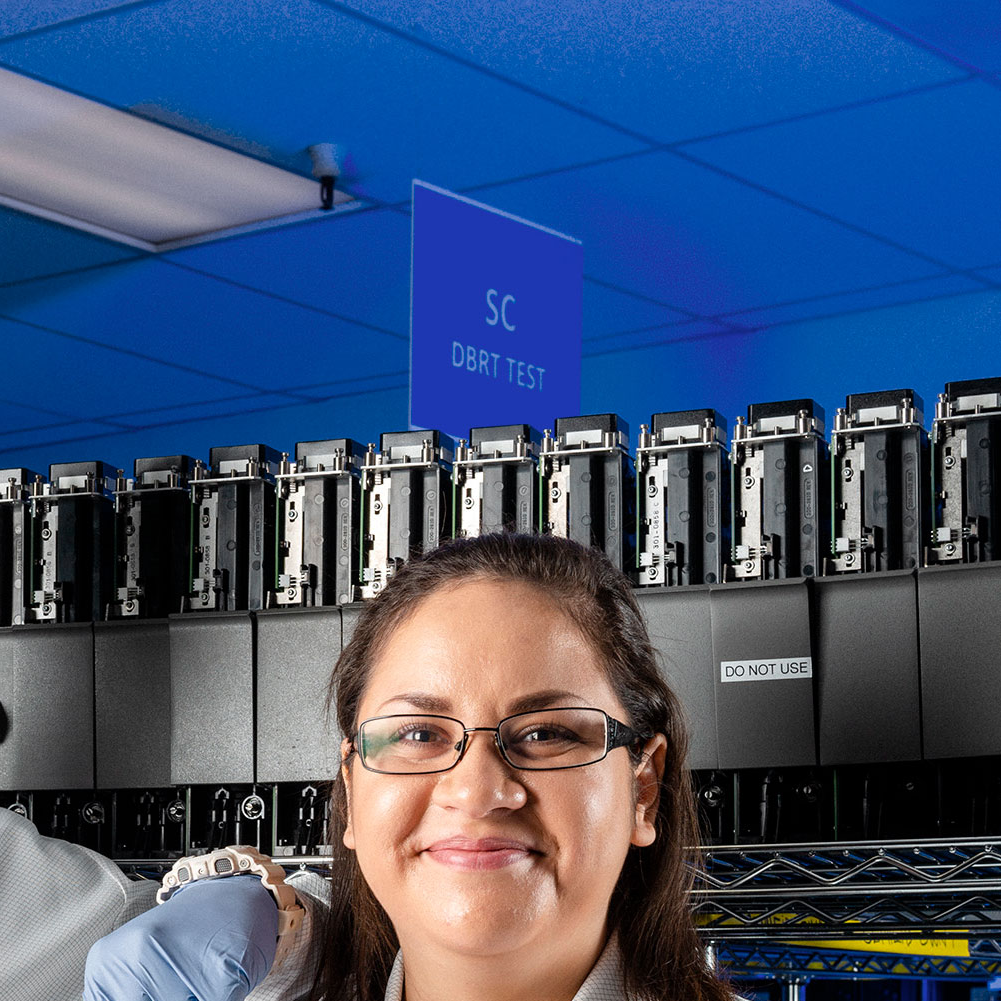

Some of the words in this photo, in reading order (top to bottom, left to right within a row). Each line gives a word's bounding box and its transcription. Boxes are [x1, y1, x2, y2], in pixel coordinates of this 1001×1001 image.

[485, 288, 516, 332] SC
[452, 341, 500, 378] DBRT
[506, 357, 546, 391] TEST
[725, 665, 745, 677] DO
[749, 663, 777, 676] NOT
[780, 661, 808, 674] USE
